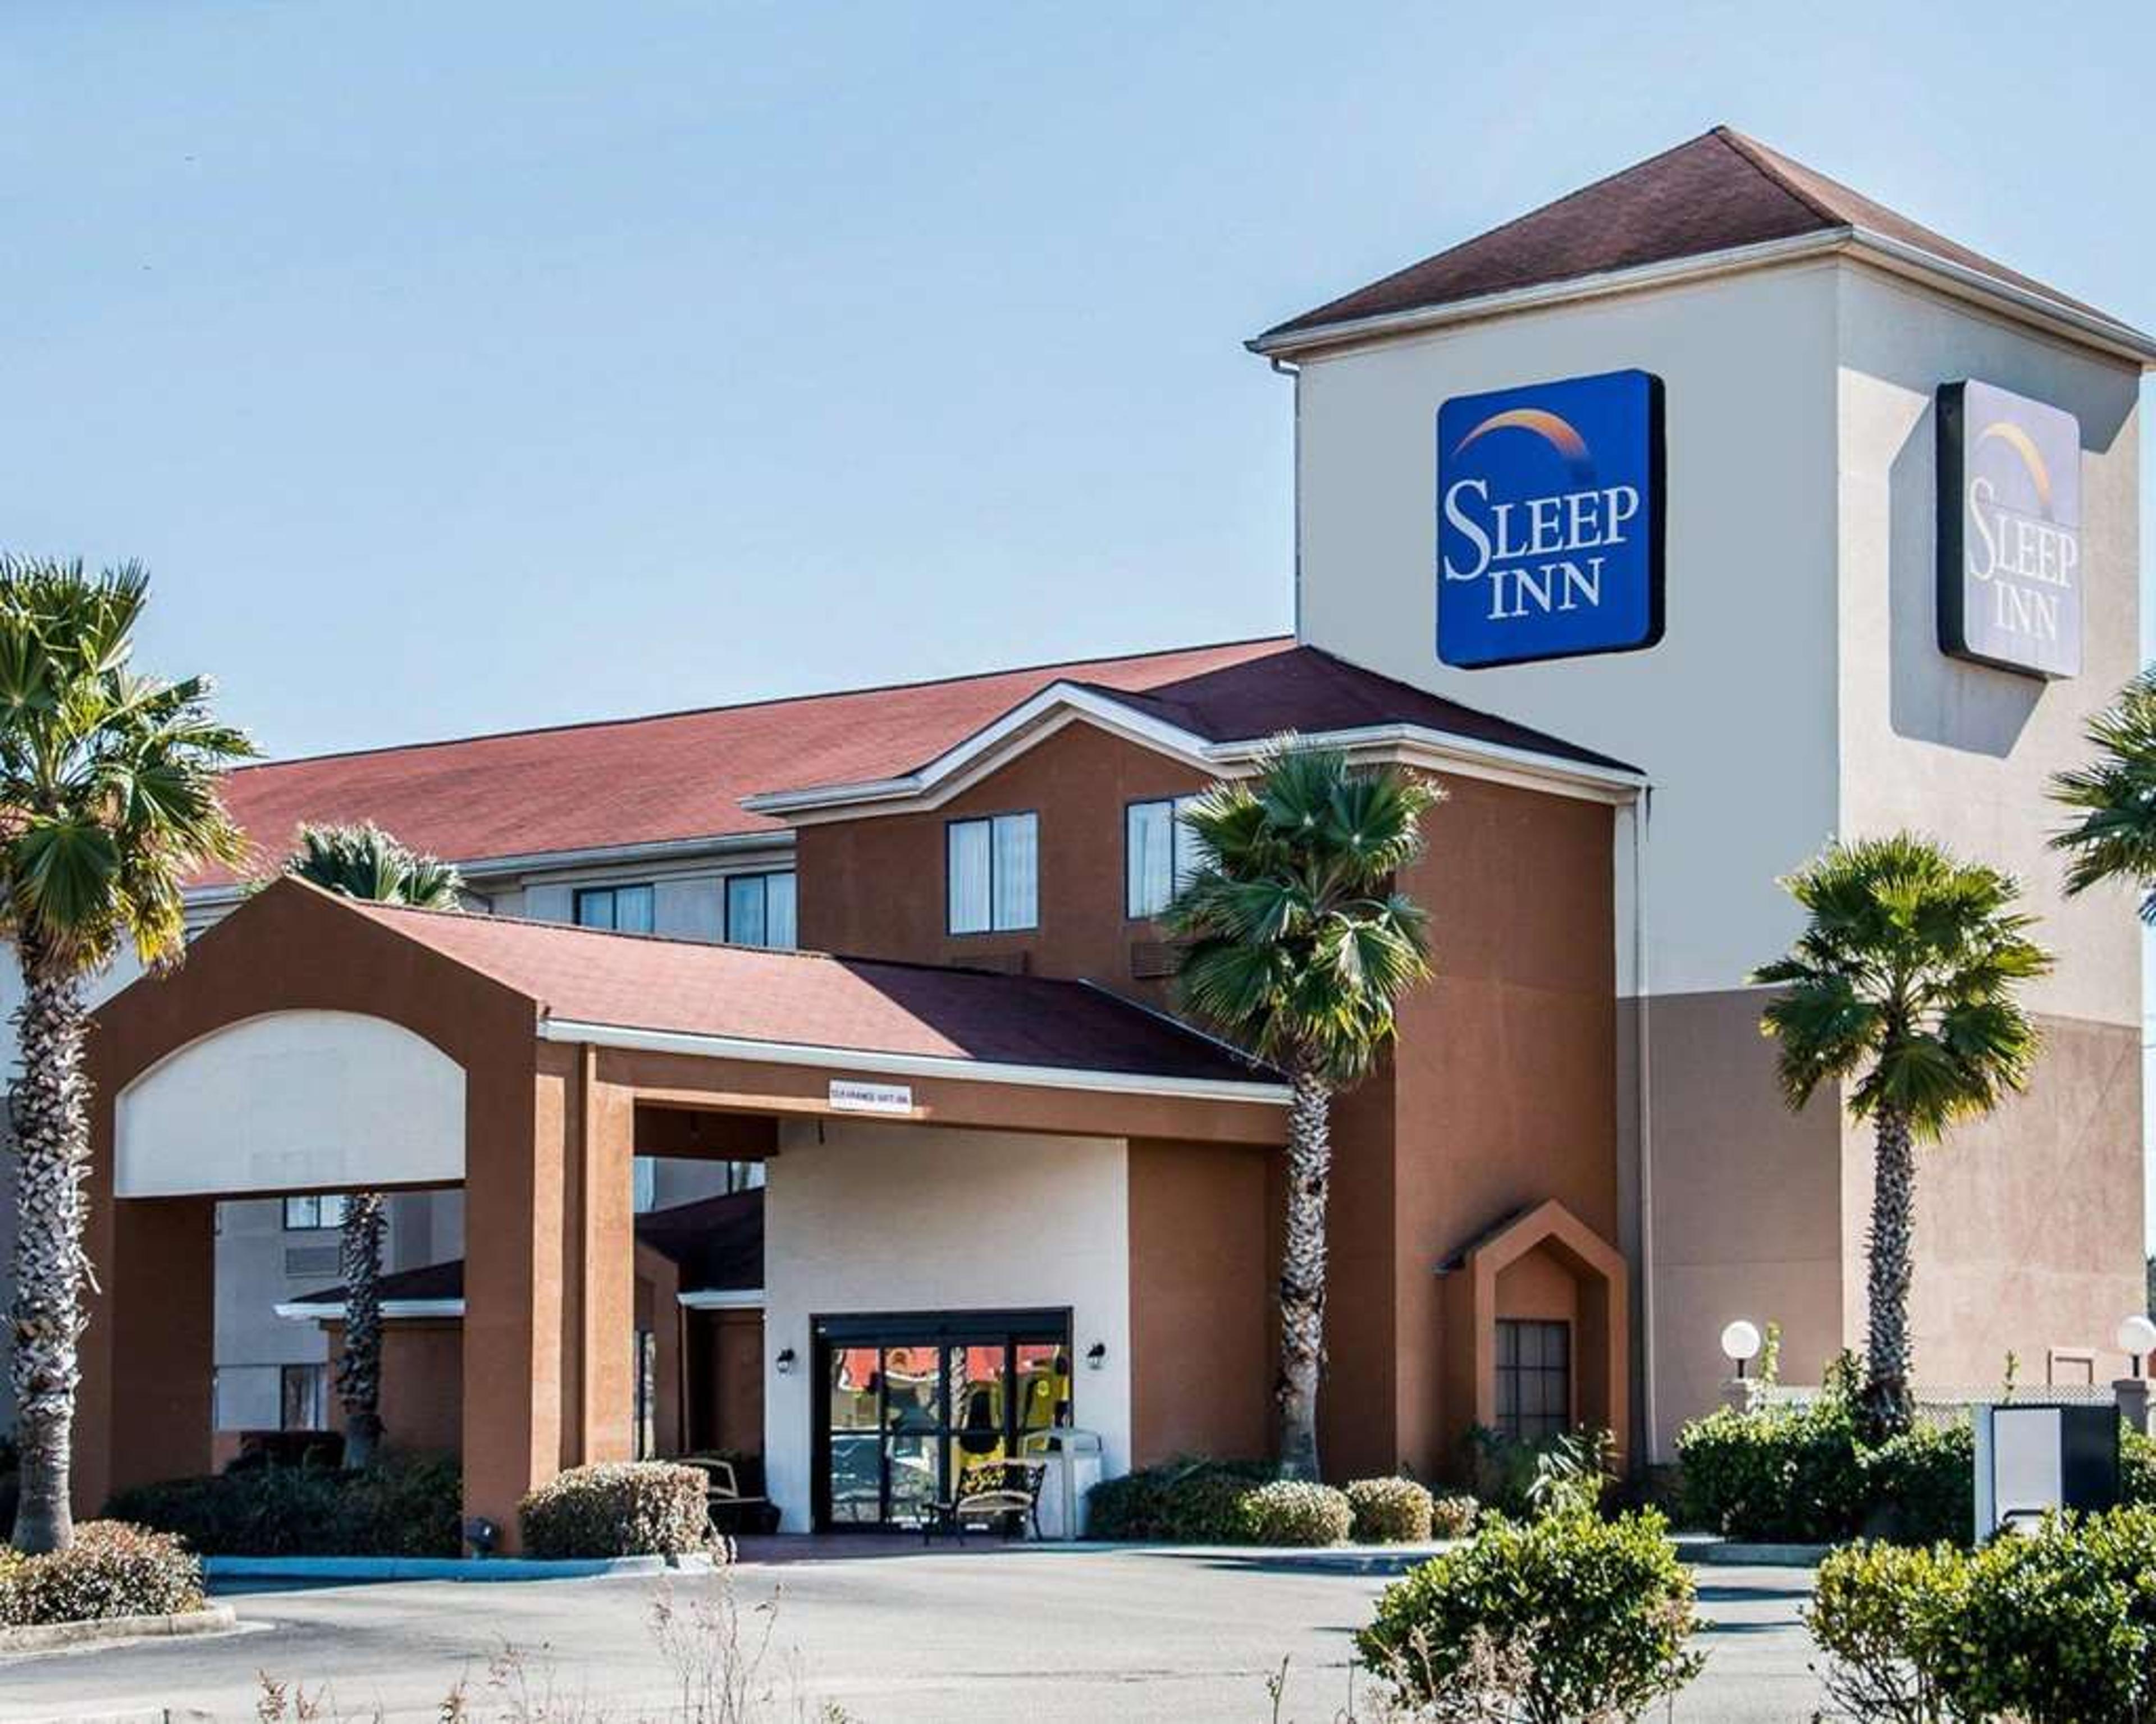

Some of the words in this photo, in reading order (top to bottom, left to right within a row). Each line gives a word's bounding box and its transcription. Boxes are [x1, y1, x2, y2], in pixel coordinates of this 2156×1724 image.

[1444, 479, 1639, 581] SLEEP
[1968, 477, 2077, 588] SLEEP
[1487, 557, 1605, 619] INN
[1994, 580, 2059, 641] INN
